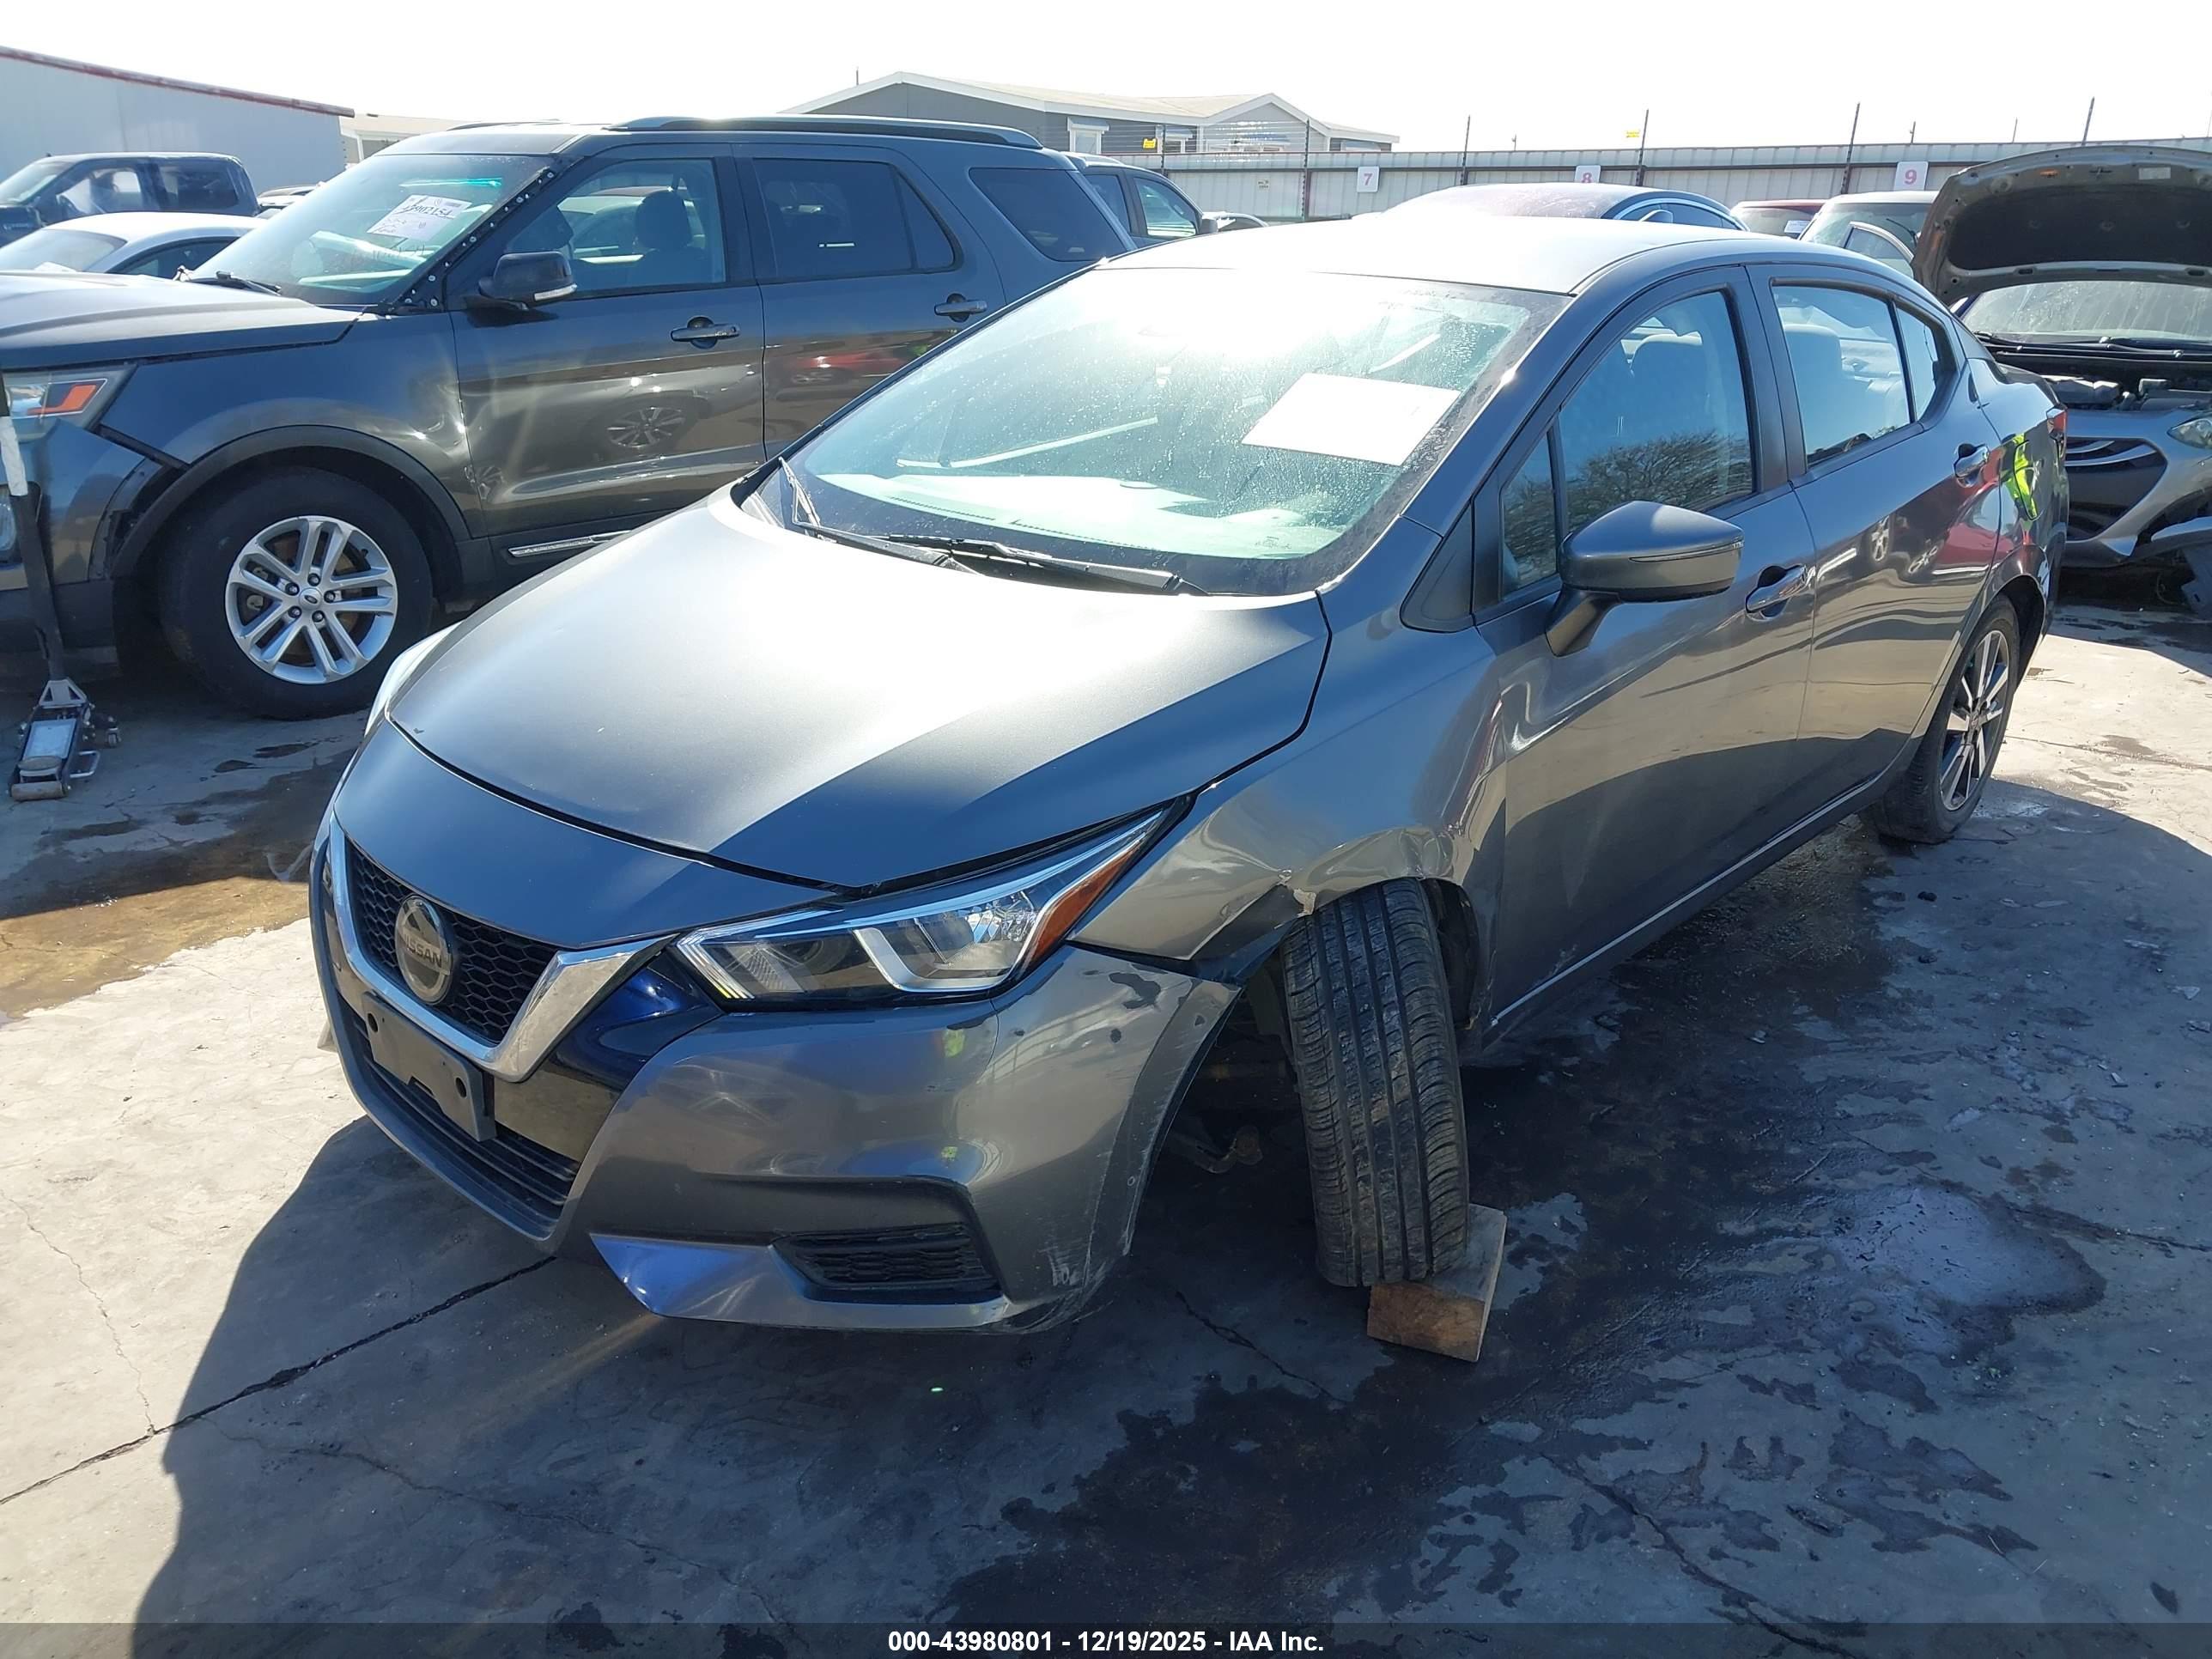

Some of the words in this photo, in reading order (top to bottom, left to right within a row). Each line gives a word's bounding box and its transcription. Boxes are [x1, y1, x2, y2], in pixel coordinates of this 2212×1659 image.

[1364, 173, 1373, 185] 7
[1582, 172, 1592, 183] 8
[1904, 169, 1917, 185] 9
